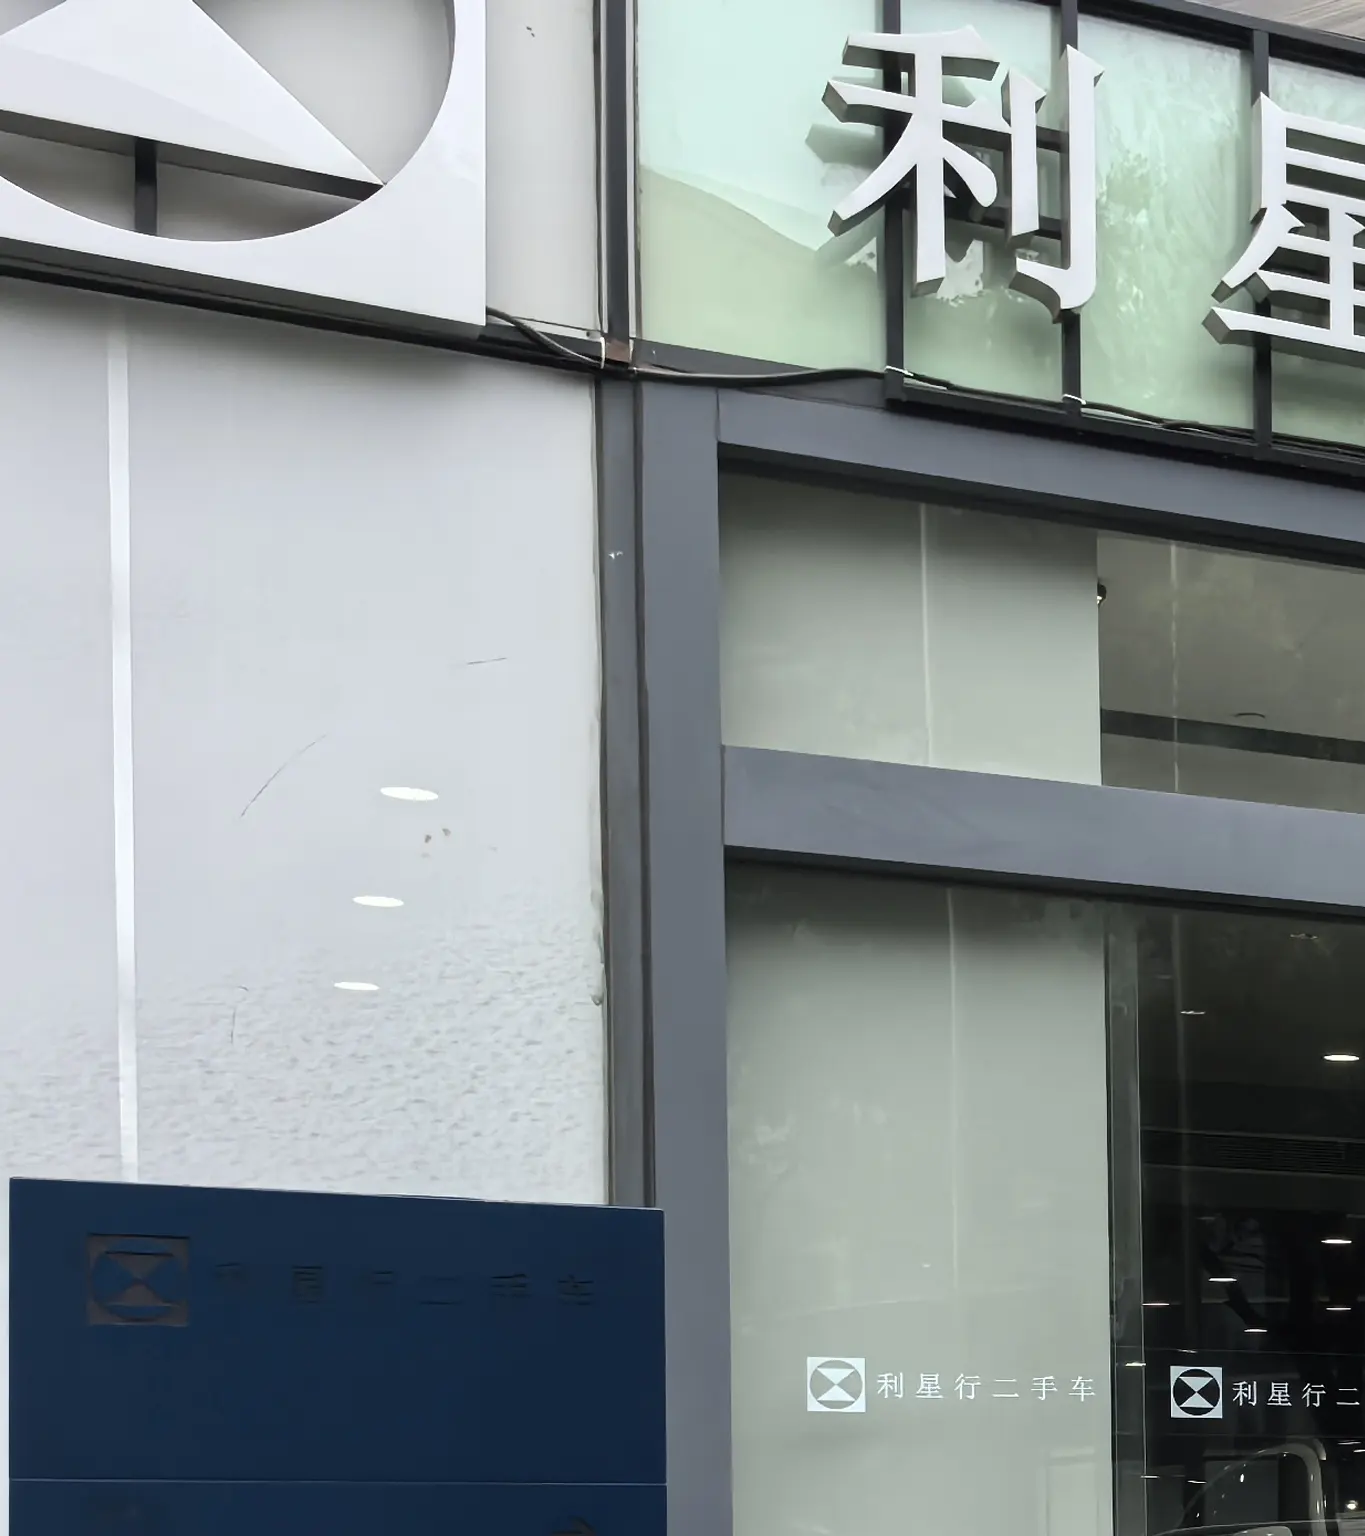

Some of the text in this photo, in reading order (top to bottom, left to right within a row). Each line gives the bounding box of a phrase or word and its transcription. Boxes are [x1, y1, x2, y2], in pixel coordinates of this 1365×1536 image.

[876, 1371, 1097, 1402] 利星行二手车
